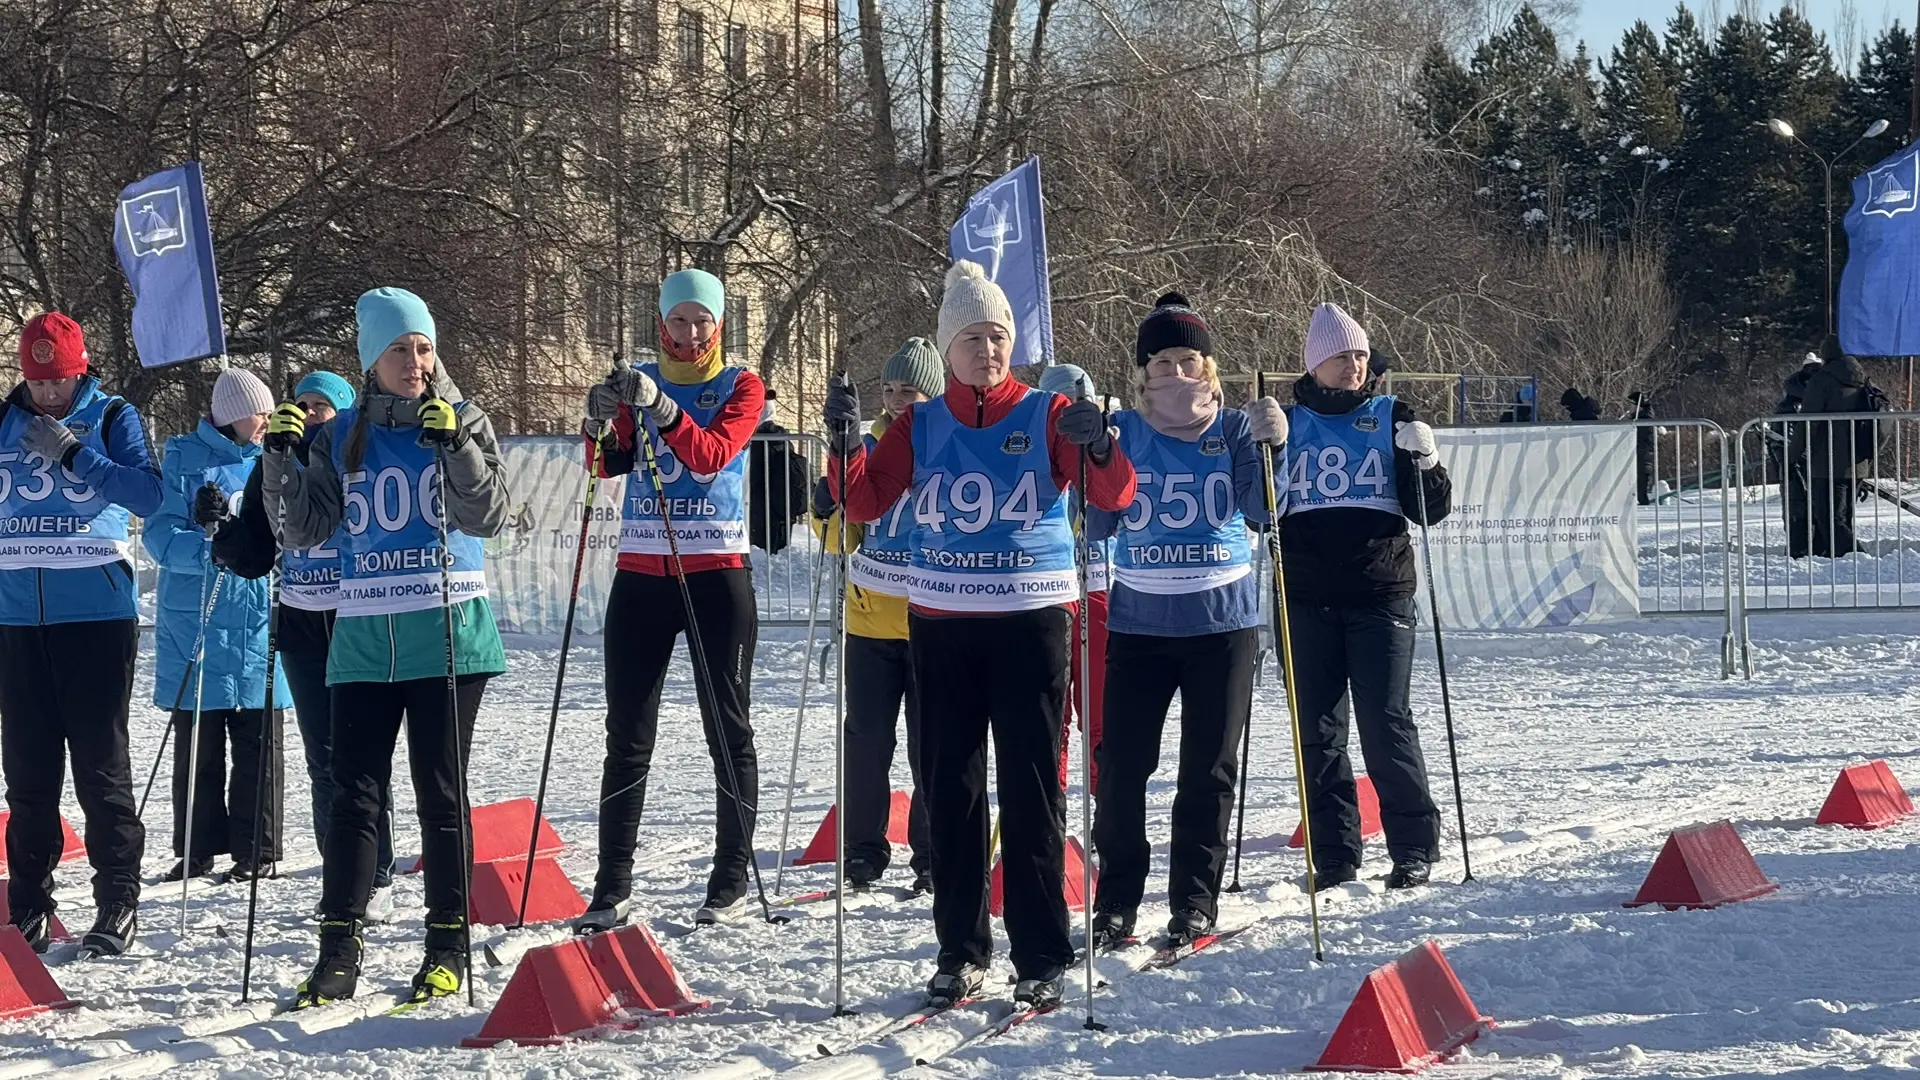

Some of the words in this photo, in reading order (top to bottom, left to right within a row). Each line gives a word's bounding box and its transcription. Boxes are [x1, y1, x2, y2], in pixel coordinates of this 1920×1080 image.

[1288, 446, 1389, 500] 484
[630, 498, 716, 515] ТЮМЕНЬ
[915, 470, 1043, 534] 494
[1122, 471, 1234, 531] 550
[1465, 520, 1473, 528] И
[1476, 516, 1556, 529] МОЛОДЕЖНОЙ
[1559, 515, 1619, 527] ПОЛИТИКЕ
[658, 529, 701, 540] ГОРОДА
[1505, 533, 1549, 544] ГОРОДА
[1551, 532, 1601, 542] ТЮМЕНИ
[24, 545, 73, 556] ГОРОДА
[77, 545, 120, 557] ТЮМЕНИ
[920, 547, 1036, 568] ТЮМЕНЬ
[1128, 544, 1231, 564] ТЮМЕНЬ
[354, 547, 456, 574] ТЮМЕНЬ
[861, 565, 885, 580] ГЛАВЫ
[353, 588, 386, 600] ГЛАВЫ
[390, 583, 440, 597] ГОРОДА
[920, 579, 954, 594] ГЛАВЫ
[959, 583, 1016, 596] ГОРОДА
[1020, 580, 1071, 593] ТЮМЕНИ
